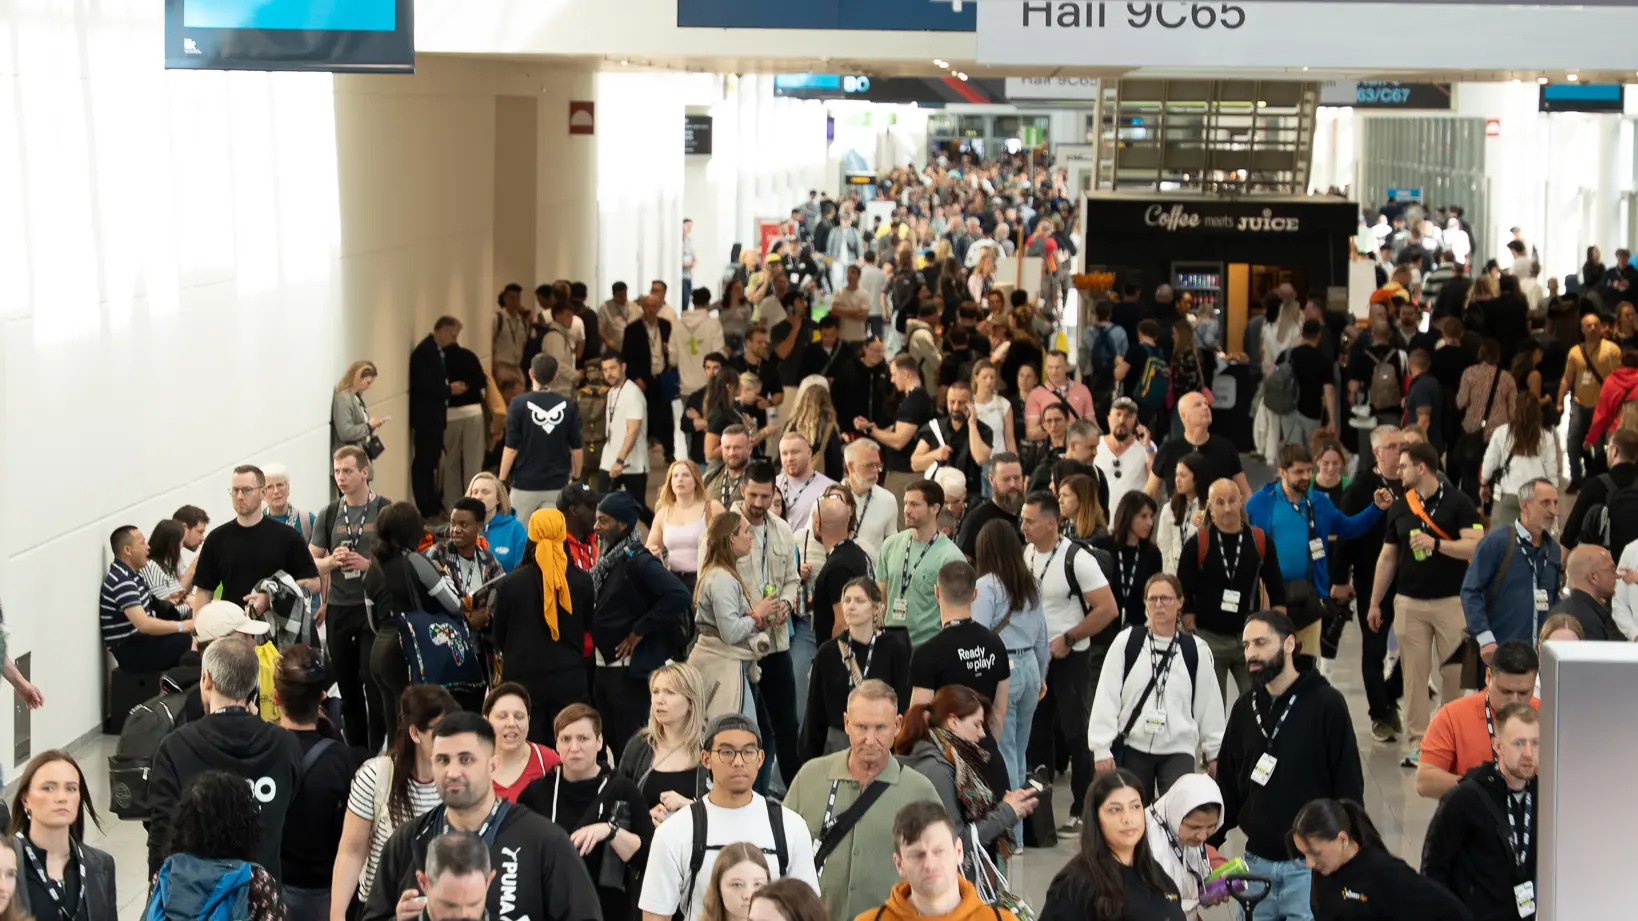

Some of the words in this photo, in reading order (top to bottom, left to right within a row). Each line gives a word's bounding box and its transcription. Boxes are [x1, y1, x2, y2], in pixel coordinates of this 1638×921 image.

[1022, 1, 1105, 28] Hall
[1126, 1, 1246, 29] 9C65
[1144, 203, 1201, 232] Coffee
[1204, 214, 1235, 228] meets
[957, 645, 986, 661] Ready
[966, 660, 974, 670] to
[973, 652, 996, 672] play?
[499, 861, 518, 916] PUMA
